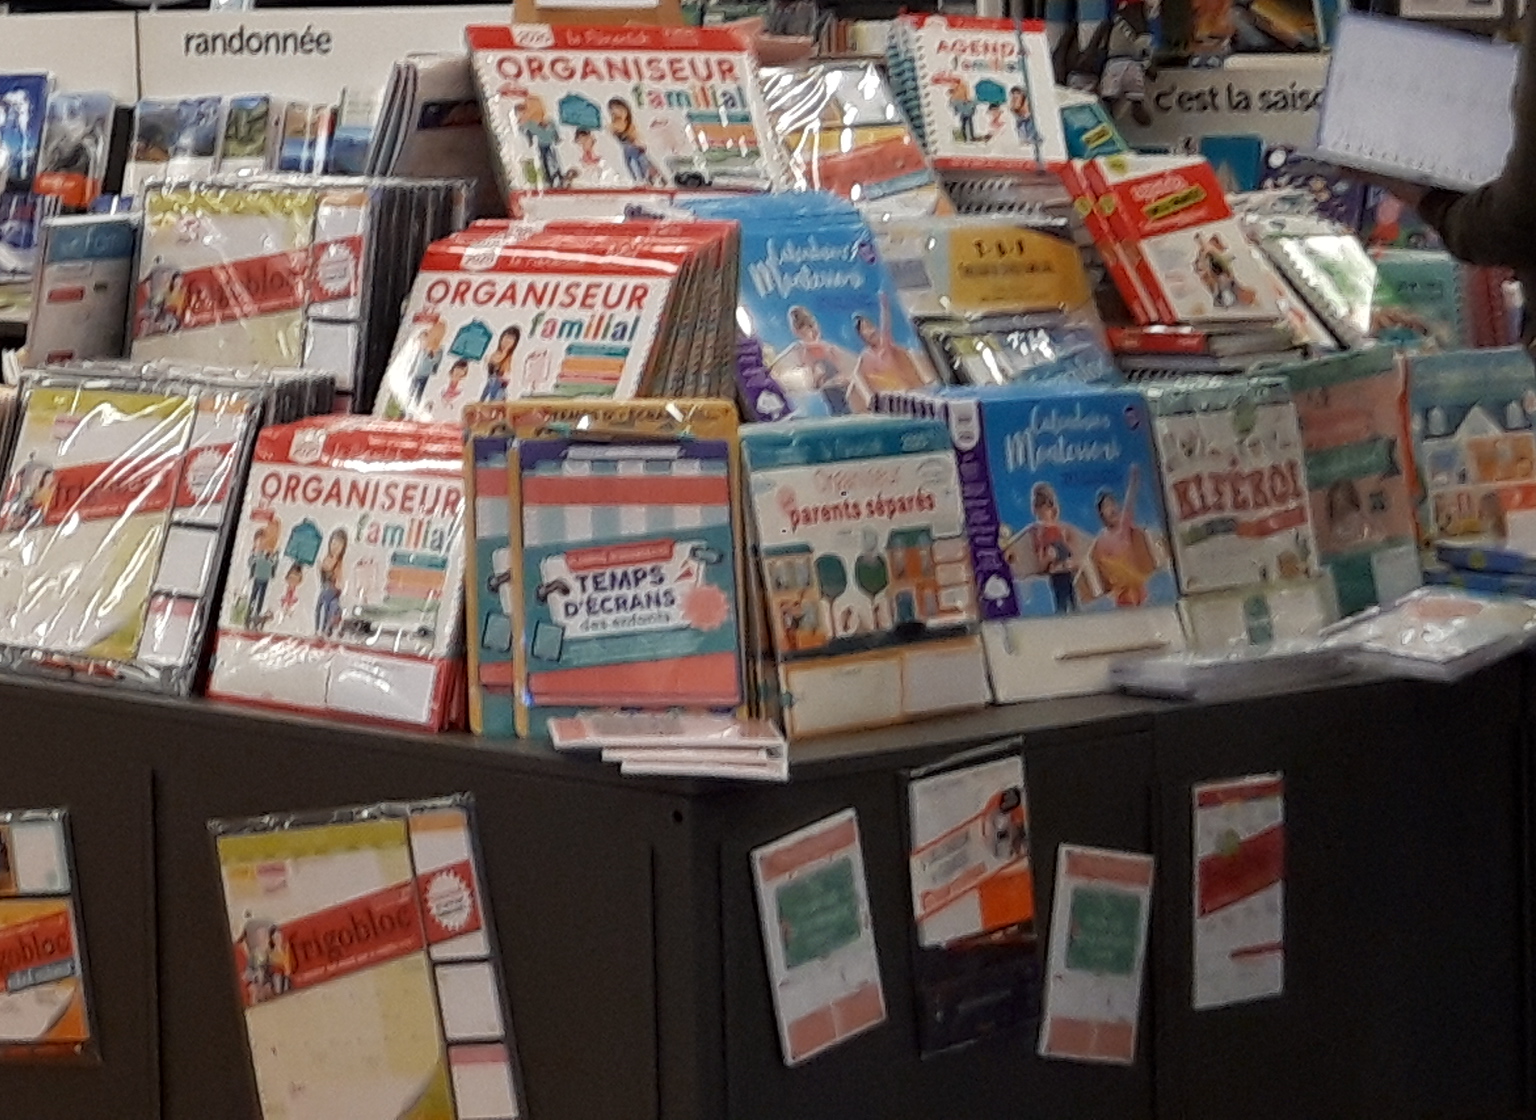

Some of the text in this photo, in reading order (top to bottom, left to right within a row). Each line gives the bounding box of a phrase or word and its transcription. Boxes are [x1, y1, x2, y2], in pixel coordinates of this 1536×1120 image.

[183, 25, 332, 56] randonnée
[936, 38, 1026, 58] AGEND
[495, 54, 738, 82] ORGANISEUR
[630, 81, 747, 109] familial
[1154, 84, 1221, 112] c'est
[1227, 82, 1252, 111] la
[426, 280, 652, 311] ORGANISEUR
[528, 310, 641, 342] familial
[260, 470, 464, 517] ORGANISEUR
[791, 486, 936, 535] parents séparés
[354, 512, 450, 552] familia
[575, 564, 666, 595] TEMPS
[286, 902, 413, 974] frigobloc
